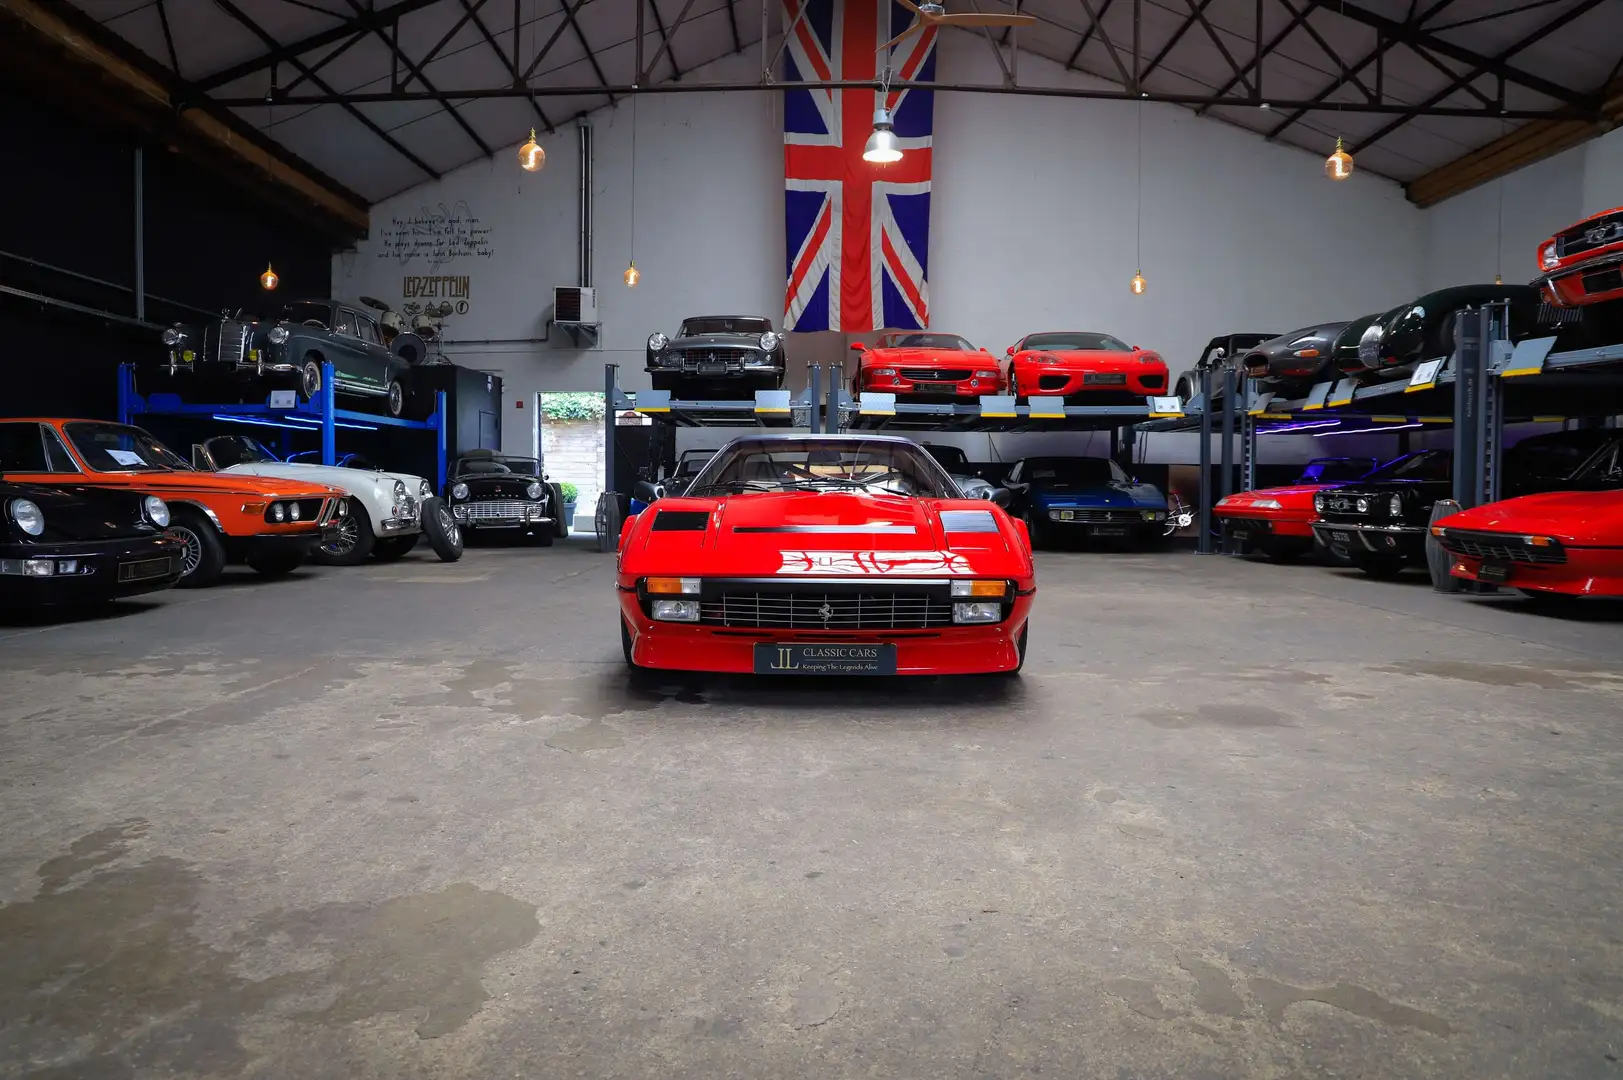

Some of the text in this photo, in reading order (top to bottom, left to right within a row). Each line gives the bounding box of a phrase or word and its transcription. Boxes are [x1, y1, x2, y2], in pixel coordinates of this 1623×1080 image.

[436, 238, 445, 246] for
[449, 238, 460, 246] Led
[464, 237, 488, 248] Zeppelin
[432, 248, 445, 257] John
[803, 648, 877, 657] CLASSIC CARS
[802, 664, 826, 672] Keeping
[839, 664, 863, 672] Legends
